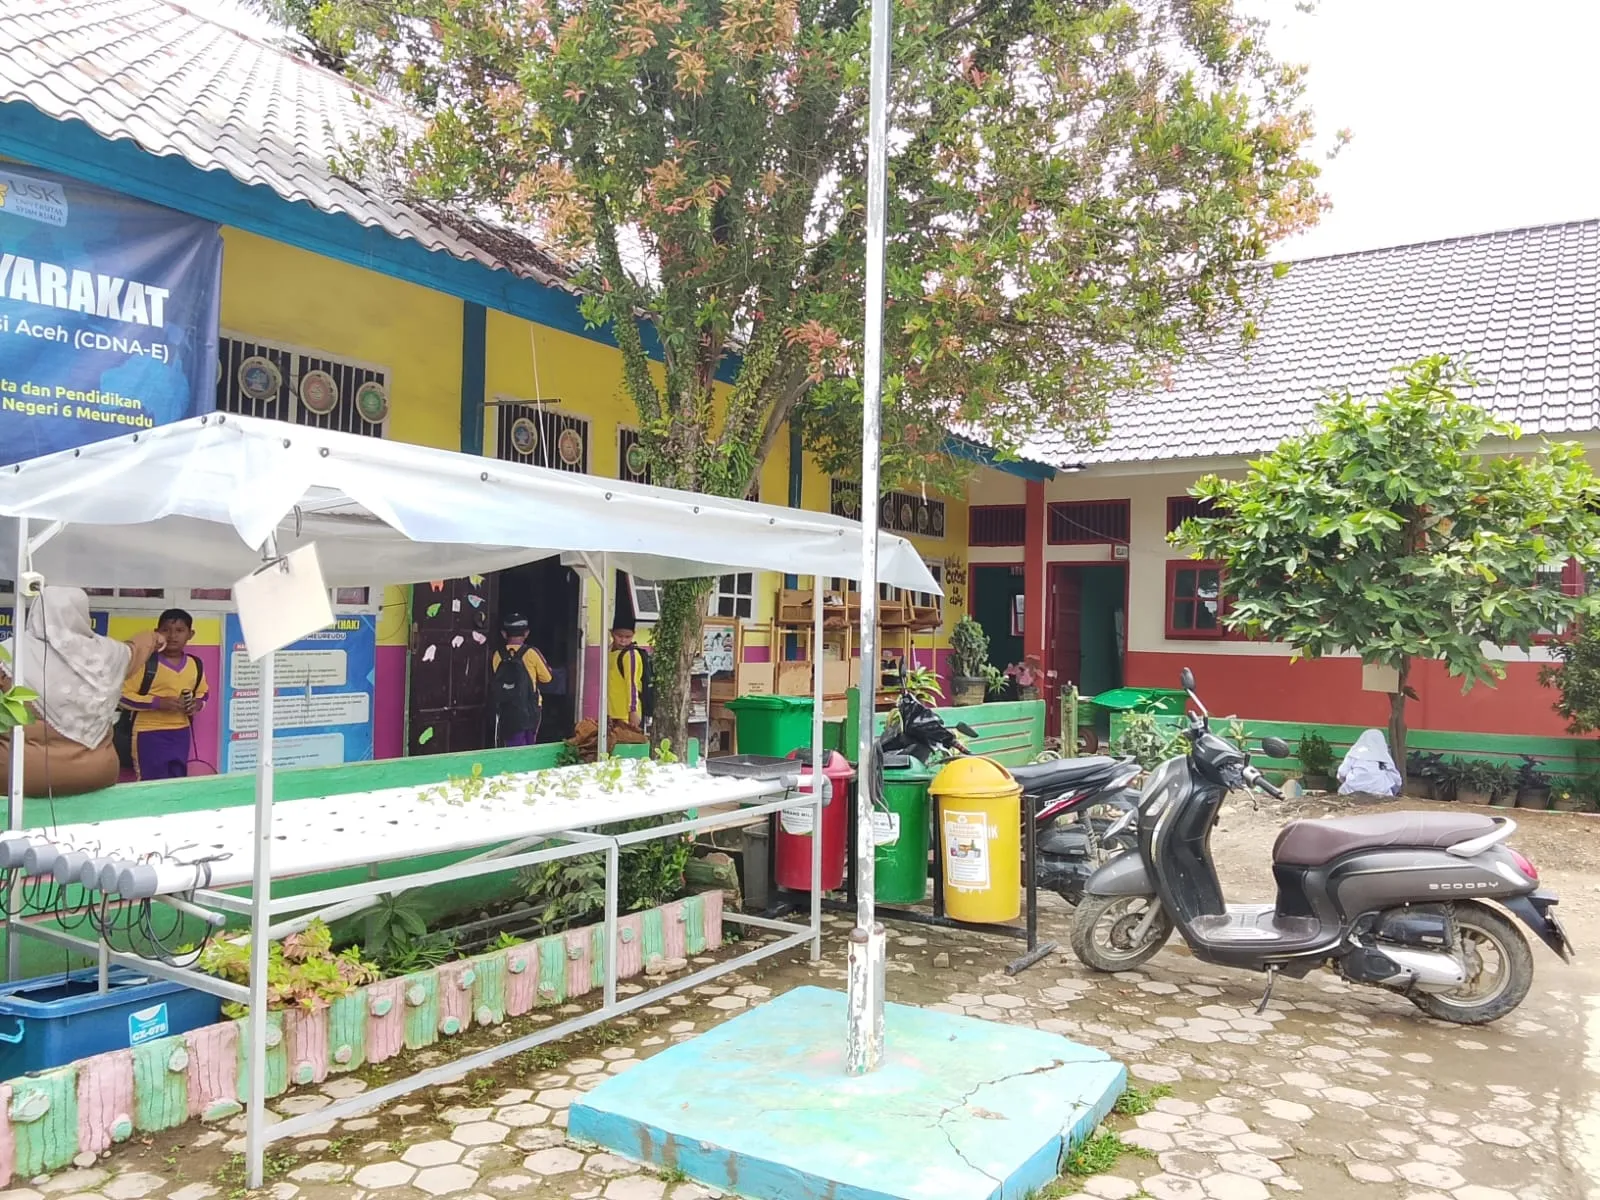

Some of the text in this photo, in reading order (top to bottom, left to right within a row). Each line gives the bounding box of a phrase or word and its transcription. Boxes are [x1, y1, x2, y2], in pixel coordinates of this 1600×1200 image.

[8, 180, 61, 205] USK
[15, 319, 69, 344] Aceh
[74, 329, 169, 364] (CDNA-E)
[21, 381, 51, 398] dan
[56, 386, 142, 410] Pendidikan
[2, 397, 153, 428] Negeri 6 Meureudu
[1428, 881, 1499, 890] SCOOPY
